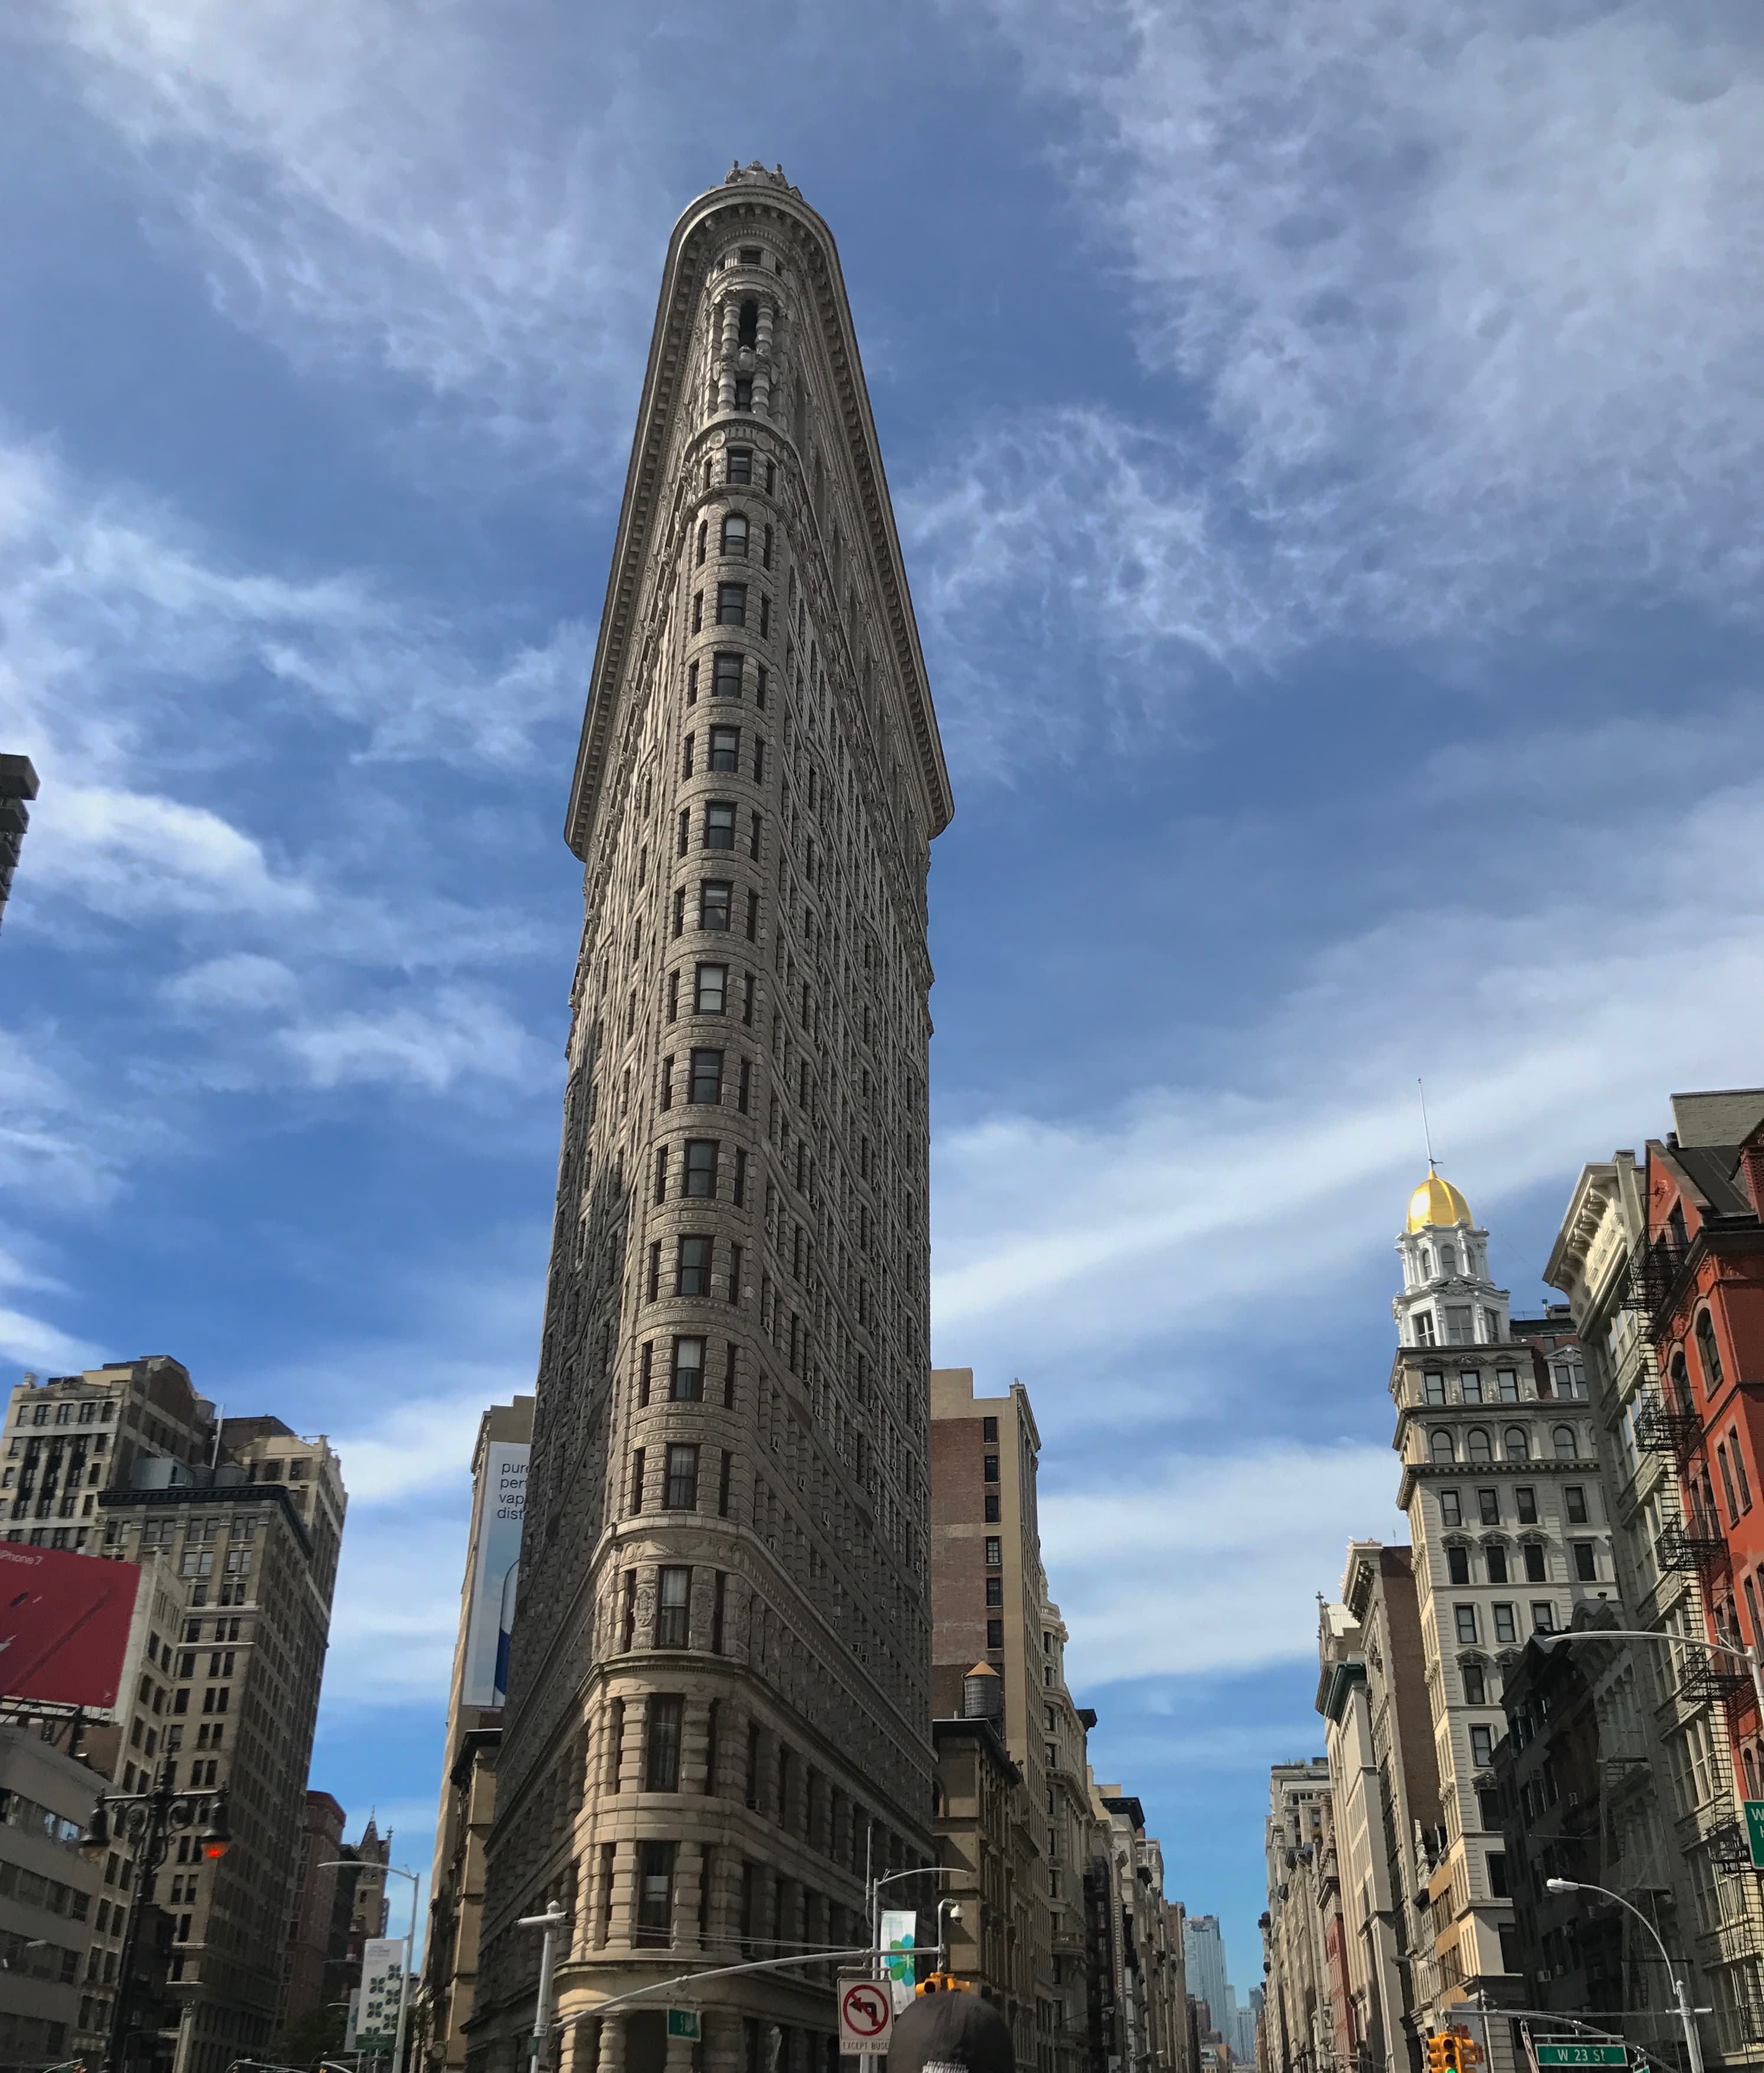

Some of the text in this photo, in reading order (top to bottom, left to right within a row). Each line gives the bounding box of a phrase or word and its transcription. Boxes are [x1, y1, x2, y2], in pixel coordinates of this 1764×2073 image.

[35, 1555, 43, 1565] 7
[843, 2042, 868, 2050] EXCEPT
[1557, 2049, 1605, 2061] W 23 St
